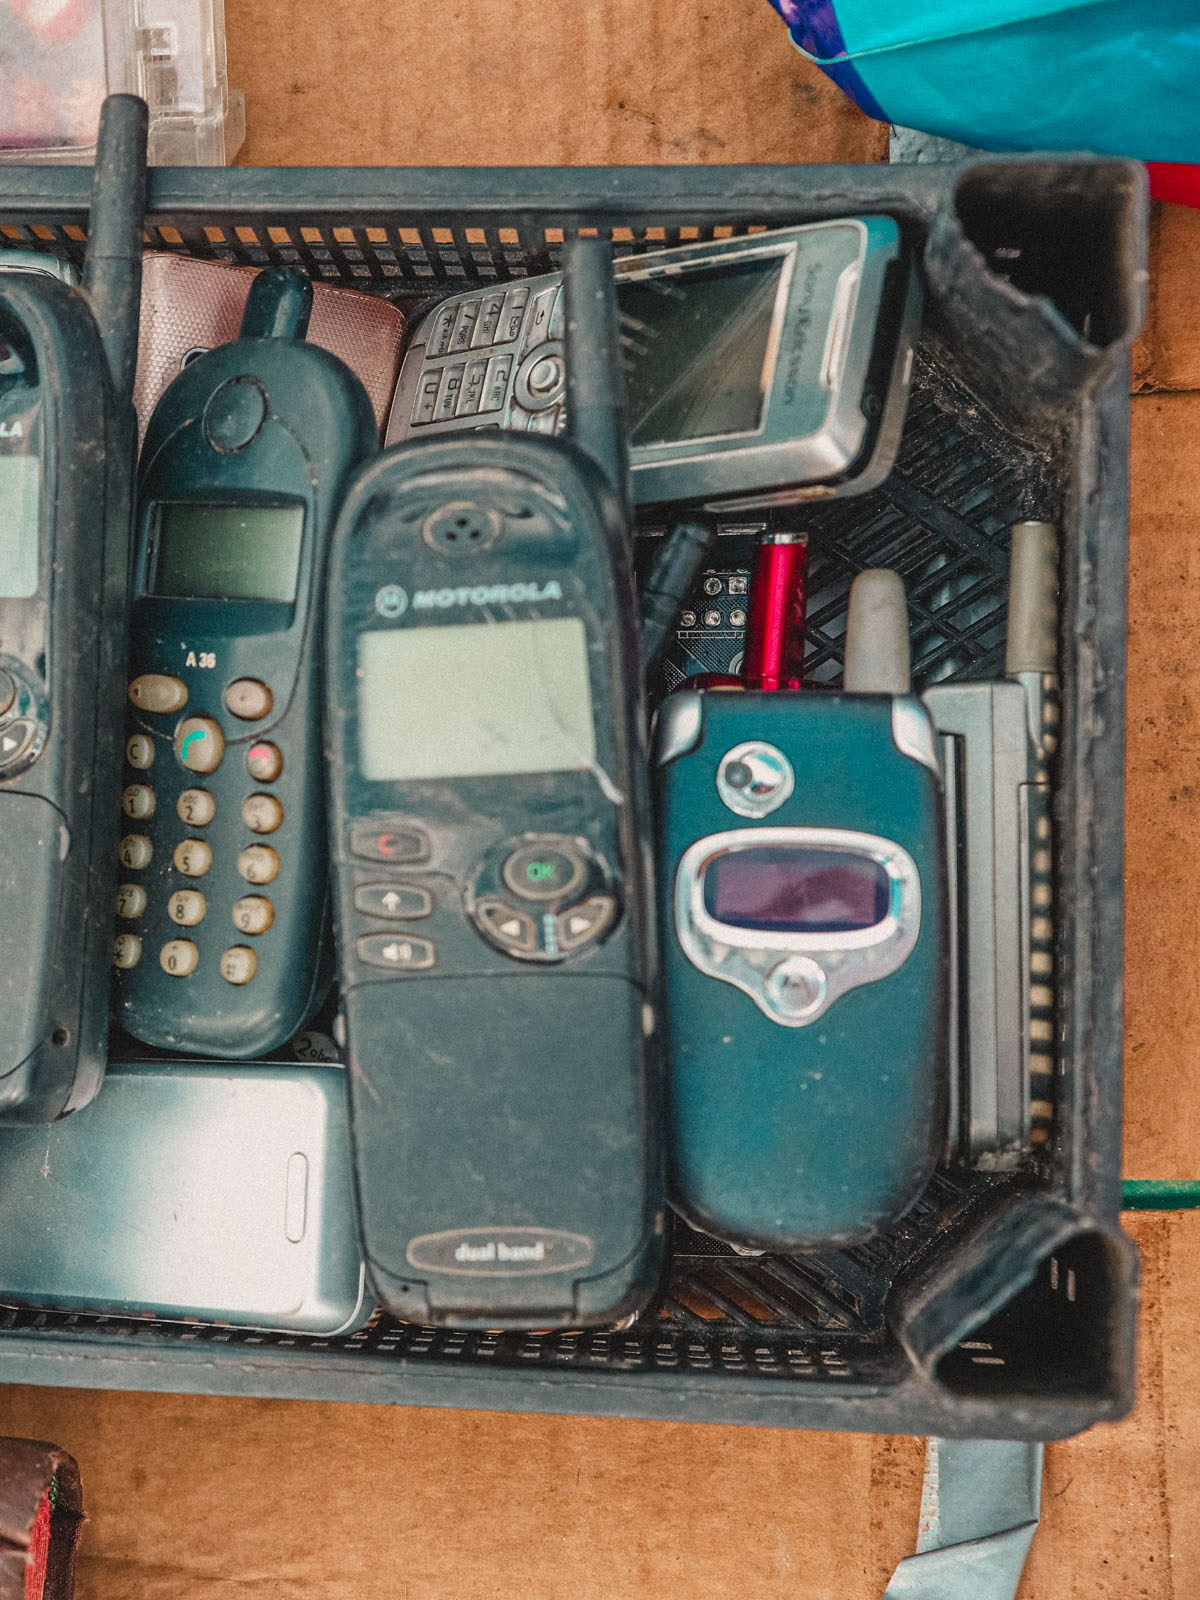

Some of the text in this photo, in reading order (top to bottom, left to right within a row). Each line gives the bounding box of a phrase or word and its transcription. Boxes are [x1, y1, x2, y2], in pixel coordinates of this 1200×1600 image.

[413, 581, 563, 609] MOTOROLA
[527, 862, 556, 881] OK
[454, 1241, 545, 1262] dual band
